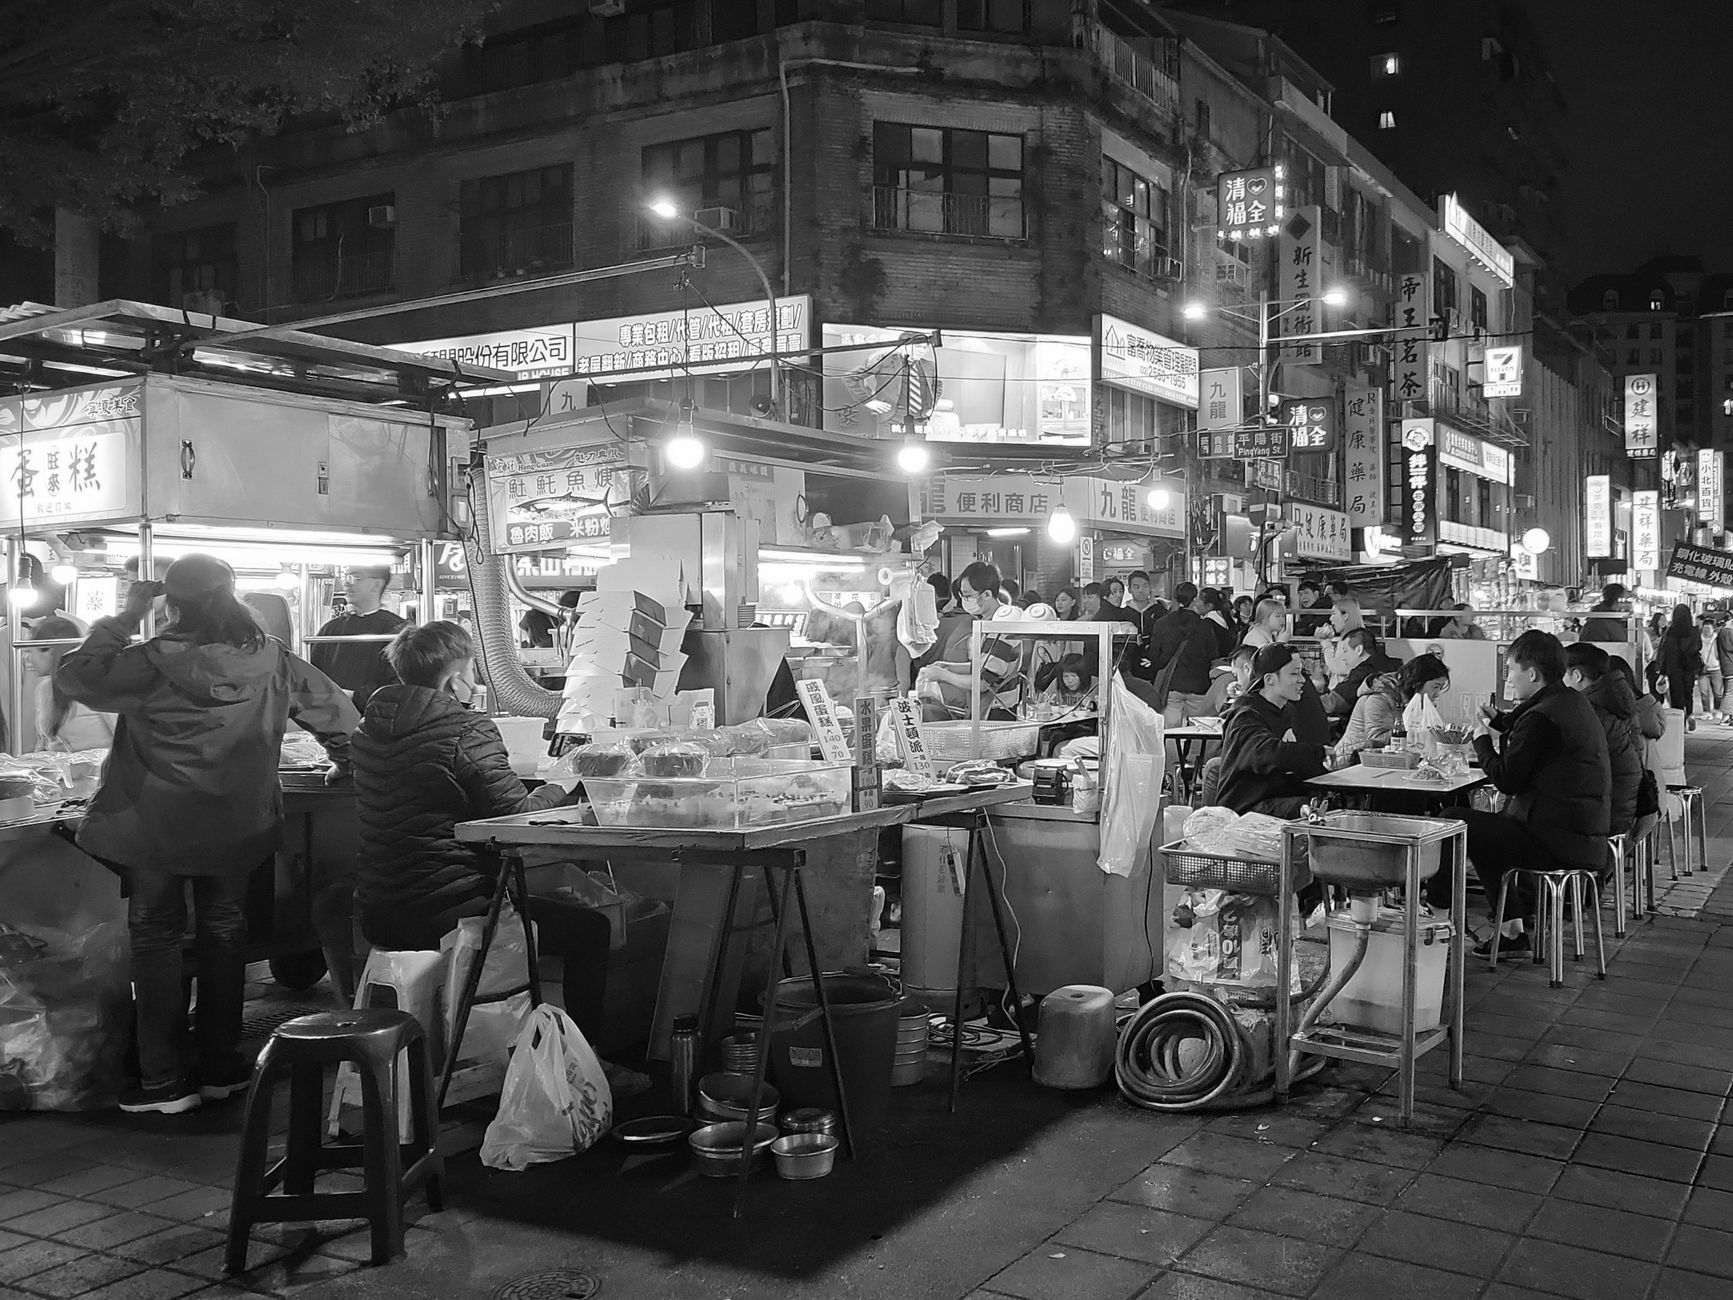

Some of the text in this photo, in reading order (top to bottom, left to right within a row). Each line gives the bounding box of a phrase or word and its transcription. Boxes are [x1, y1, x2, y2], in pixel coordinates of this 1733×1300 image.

[1226, 200, 1267, 225] 福全
[1400, 277, 1421, 397] 帝王茗茶
[1210, 381, 1227, 419] 九龍
[1631, 398, 1652, 445] 建祥
[1238, 431, 1283, 447] 平陽街
[1238, 446, 1270, 458] PingYang
[1349, 398, 1366, 514] 健康藥局
[518, 461, 554, 472] Hong Guan
[956, 491, 1049, 514] 便利商店
[1101, 483, 1137, 521] 九龍
[510, 523, 554, 545] 魯肉飯
[805, 681, 834, 728] 戚風蛋糕
[861, 701, 873, 766] 水果蛋糕
[897, 700, 924, 753] 波士頓派
[824, 735, 841, 743] 140
[831, 751, 844, 759] 70
[914, 761, 930, 771] 130
[864, 799, 874, 809] 90
